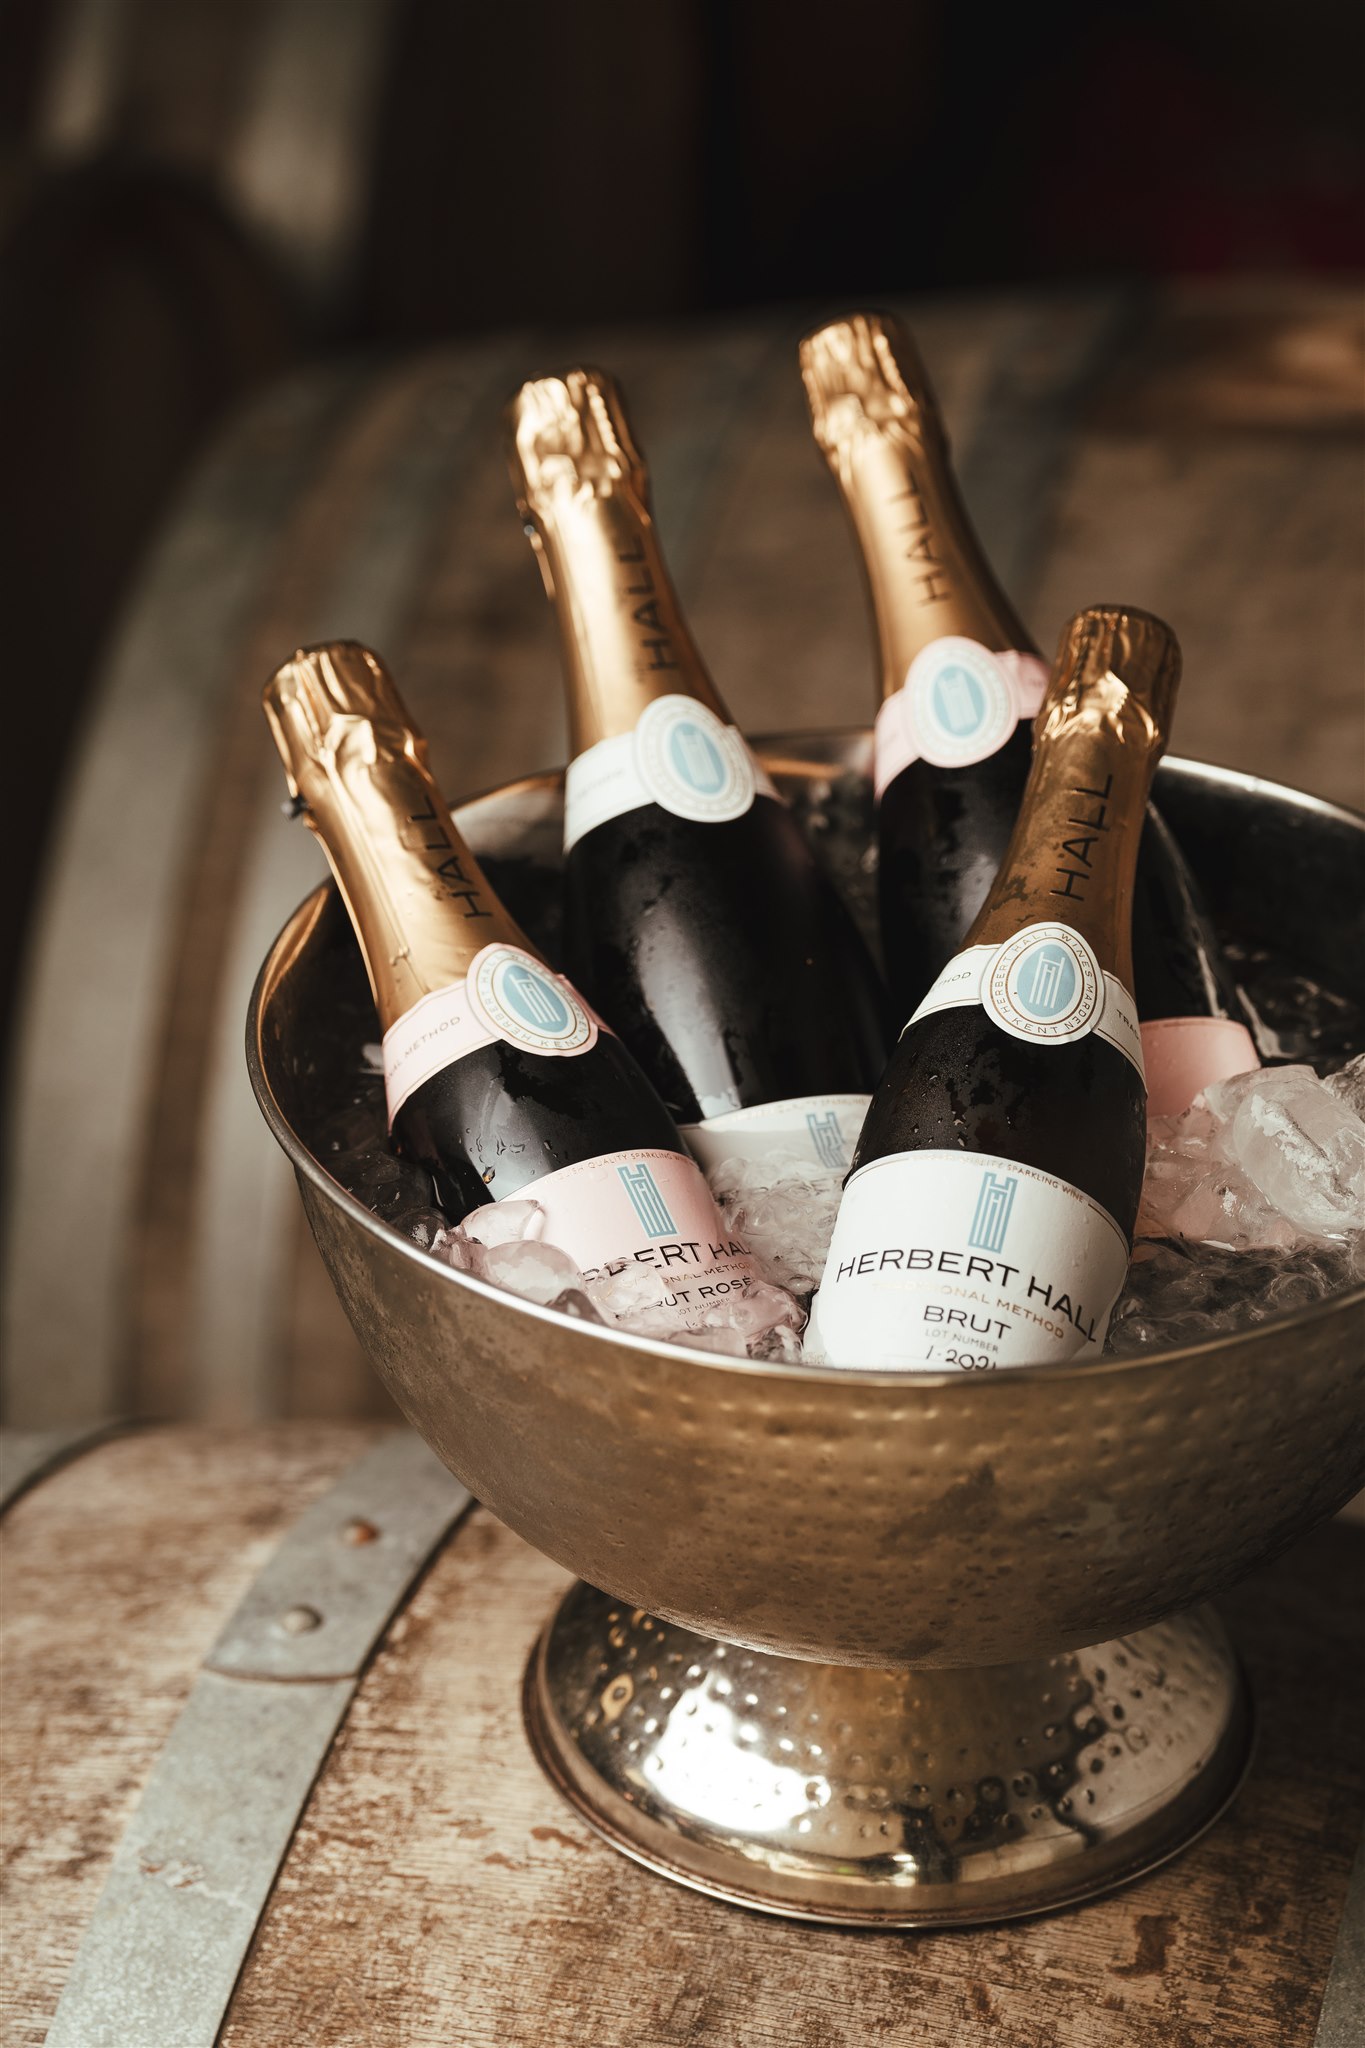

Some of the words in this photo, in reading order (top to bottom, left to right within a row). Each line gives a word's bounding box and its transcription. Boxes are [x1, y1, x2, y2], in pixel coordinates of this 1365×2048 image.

[889, 470, 953, 607] HALL
[618, 534, 680, 671] HALL
[410, 794, 494, 918] HALL
[1049, 774, 1113, 902] HALL
[1012, 931, 1053, 953] HALL
[1060, 932, 1094, 978] WINES
[994, 956, 1012, 1014] HERBERT
[1012, 1017, 1059, 1035] KENT
[1065, 983, 1095, 1031] MARDEN
[405, 1016, 461, 1058] METHOD
[540, 1036, 582, 1048] KENT
[587, 1154, 628, 1170] QUALITY
[631, 1152, 673, 1160] SPARKLING
[1006, 1164, 1060, 1190] SPARKLING
[1061, 1185, 1085, 1204] WINE
[698, 1275, 752, 1299] ROSÉ
[836, 1249, 1020, 1287] HERBERT
[1027, 1275, 1097, 1343] HALL
[923, 1305, 1012, 1340] BRUT
[998, 1298, 1064, 1339] METHOD
[925, 1328, 949, 1339] LOT
[952, 1333, 1000, 1354] NUMBER
